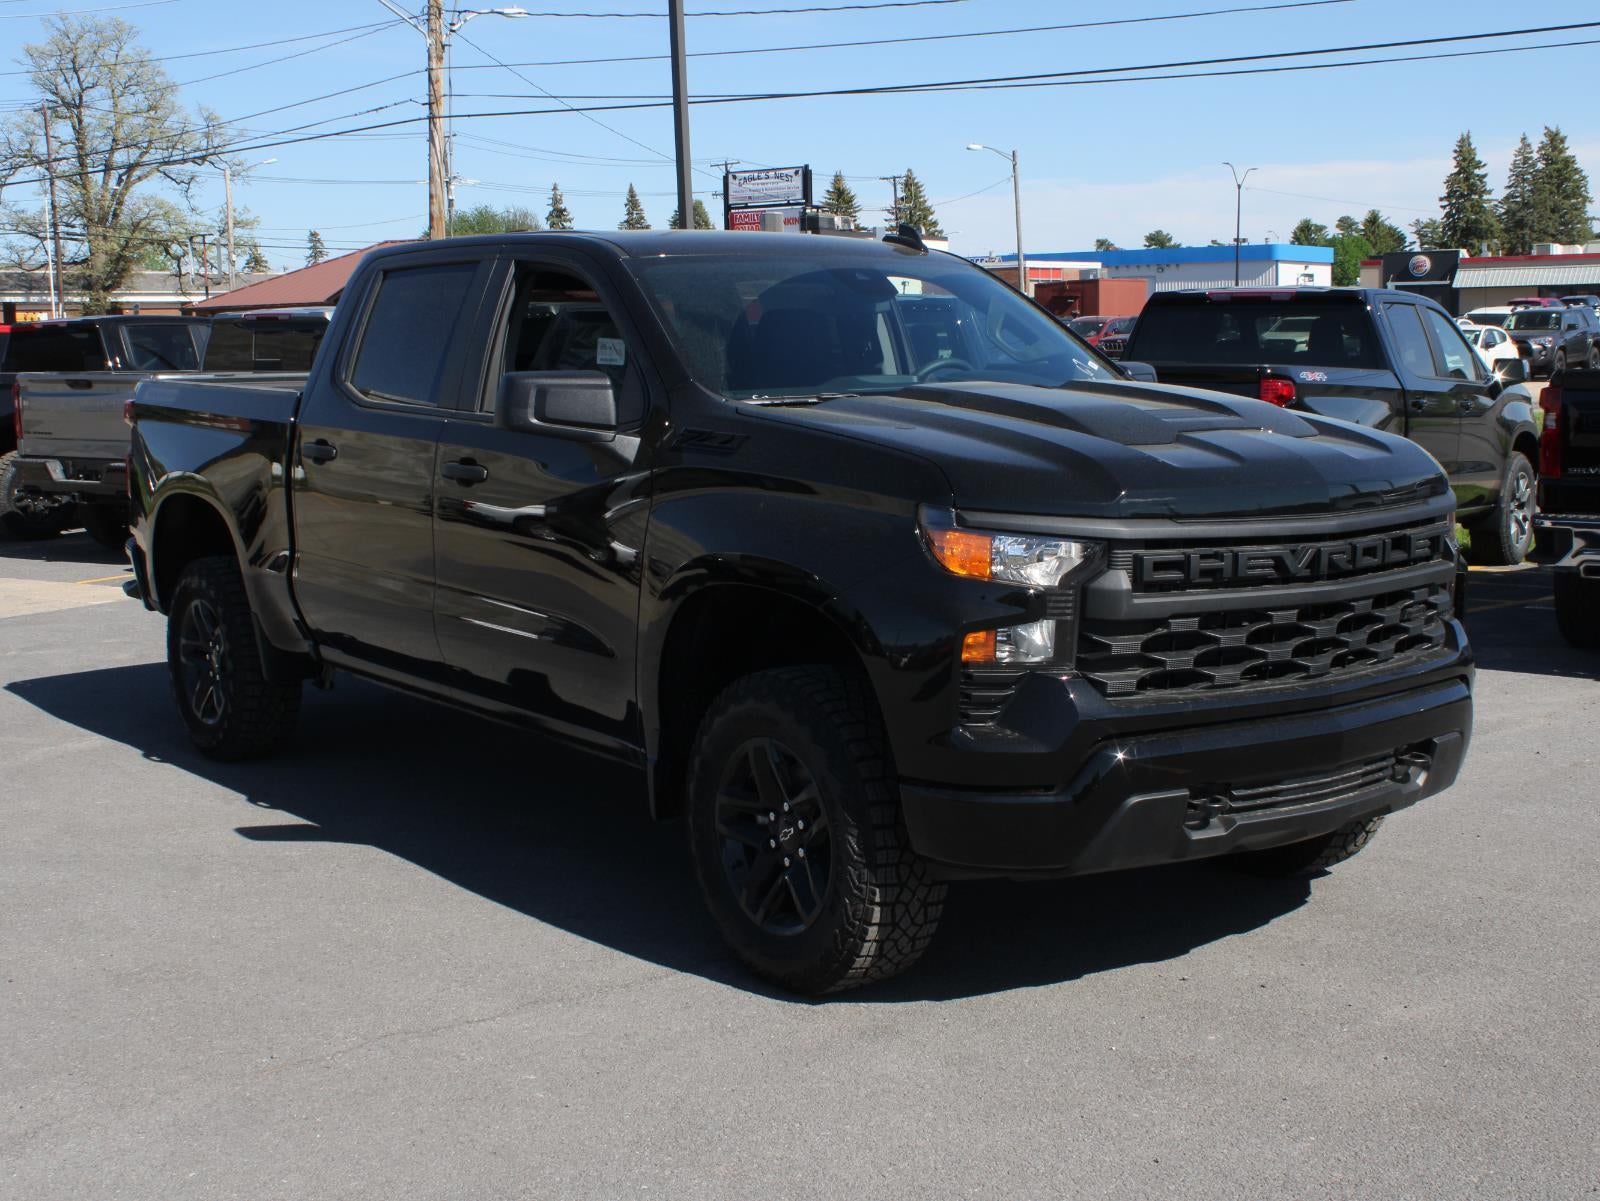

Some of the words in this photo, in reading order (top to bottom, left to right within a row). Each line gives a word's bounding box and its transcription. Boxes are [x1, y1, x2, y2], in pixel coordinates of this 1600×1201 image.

[738, 171, 770, 187] EAGLE'S
[774, 172, 793, 183] NEST
[733, 212, 761, 223] FAMILY
[1567, 467, 1600, 475] SILV
[1135, 527, 1450, 582] CHEVROLET
